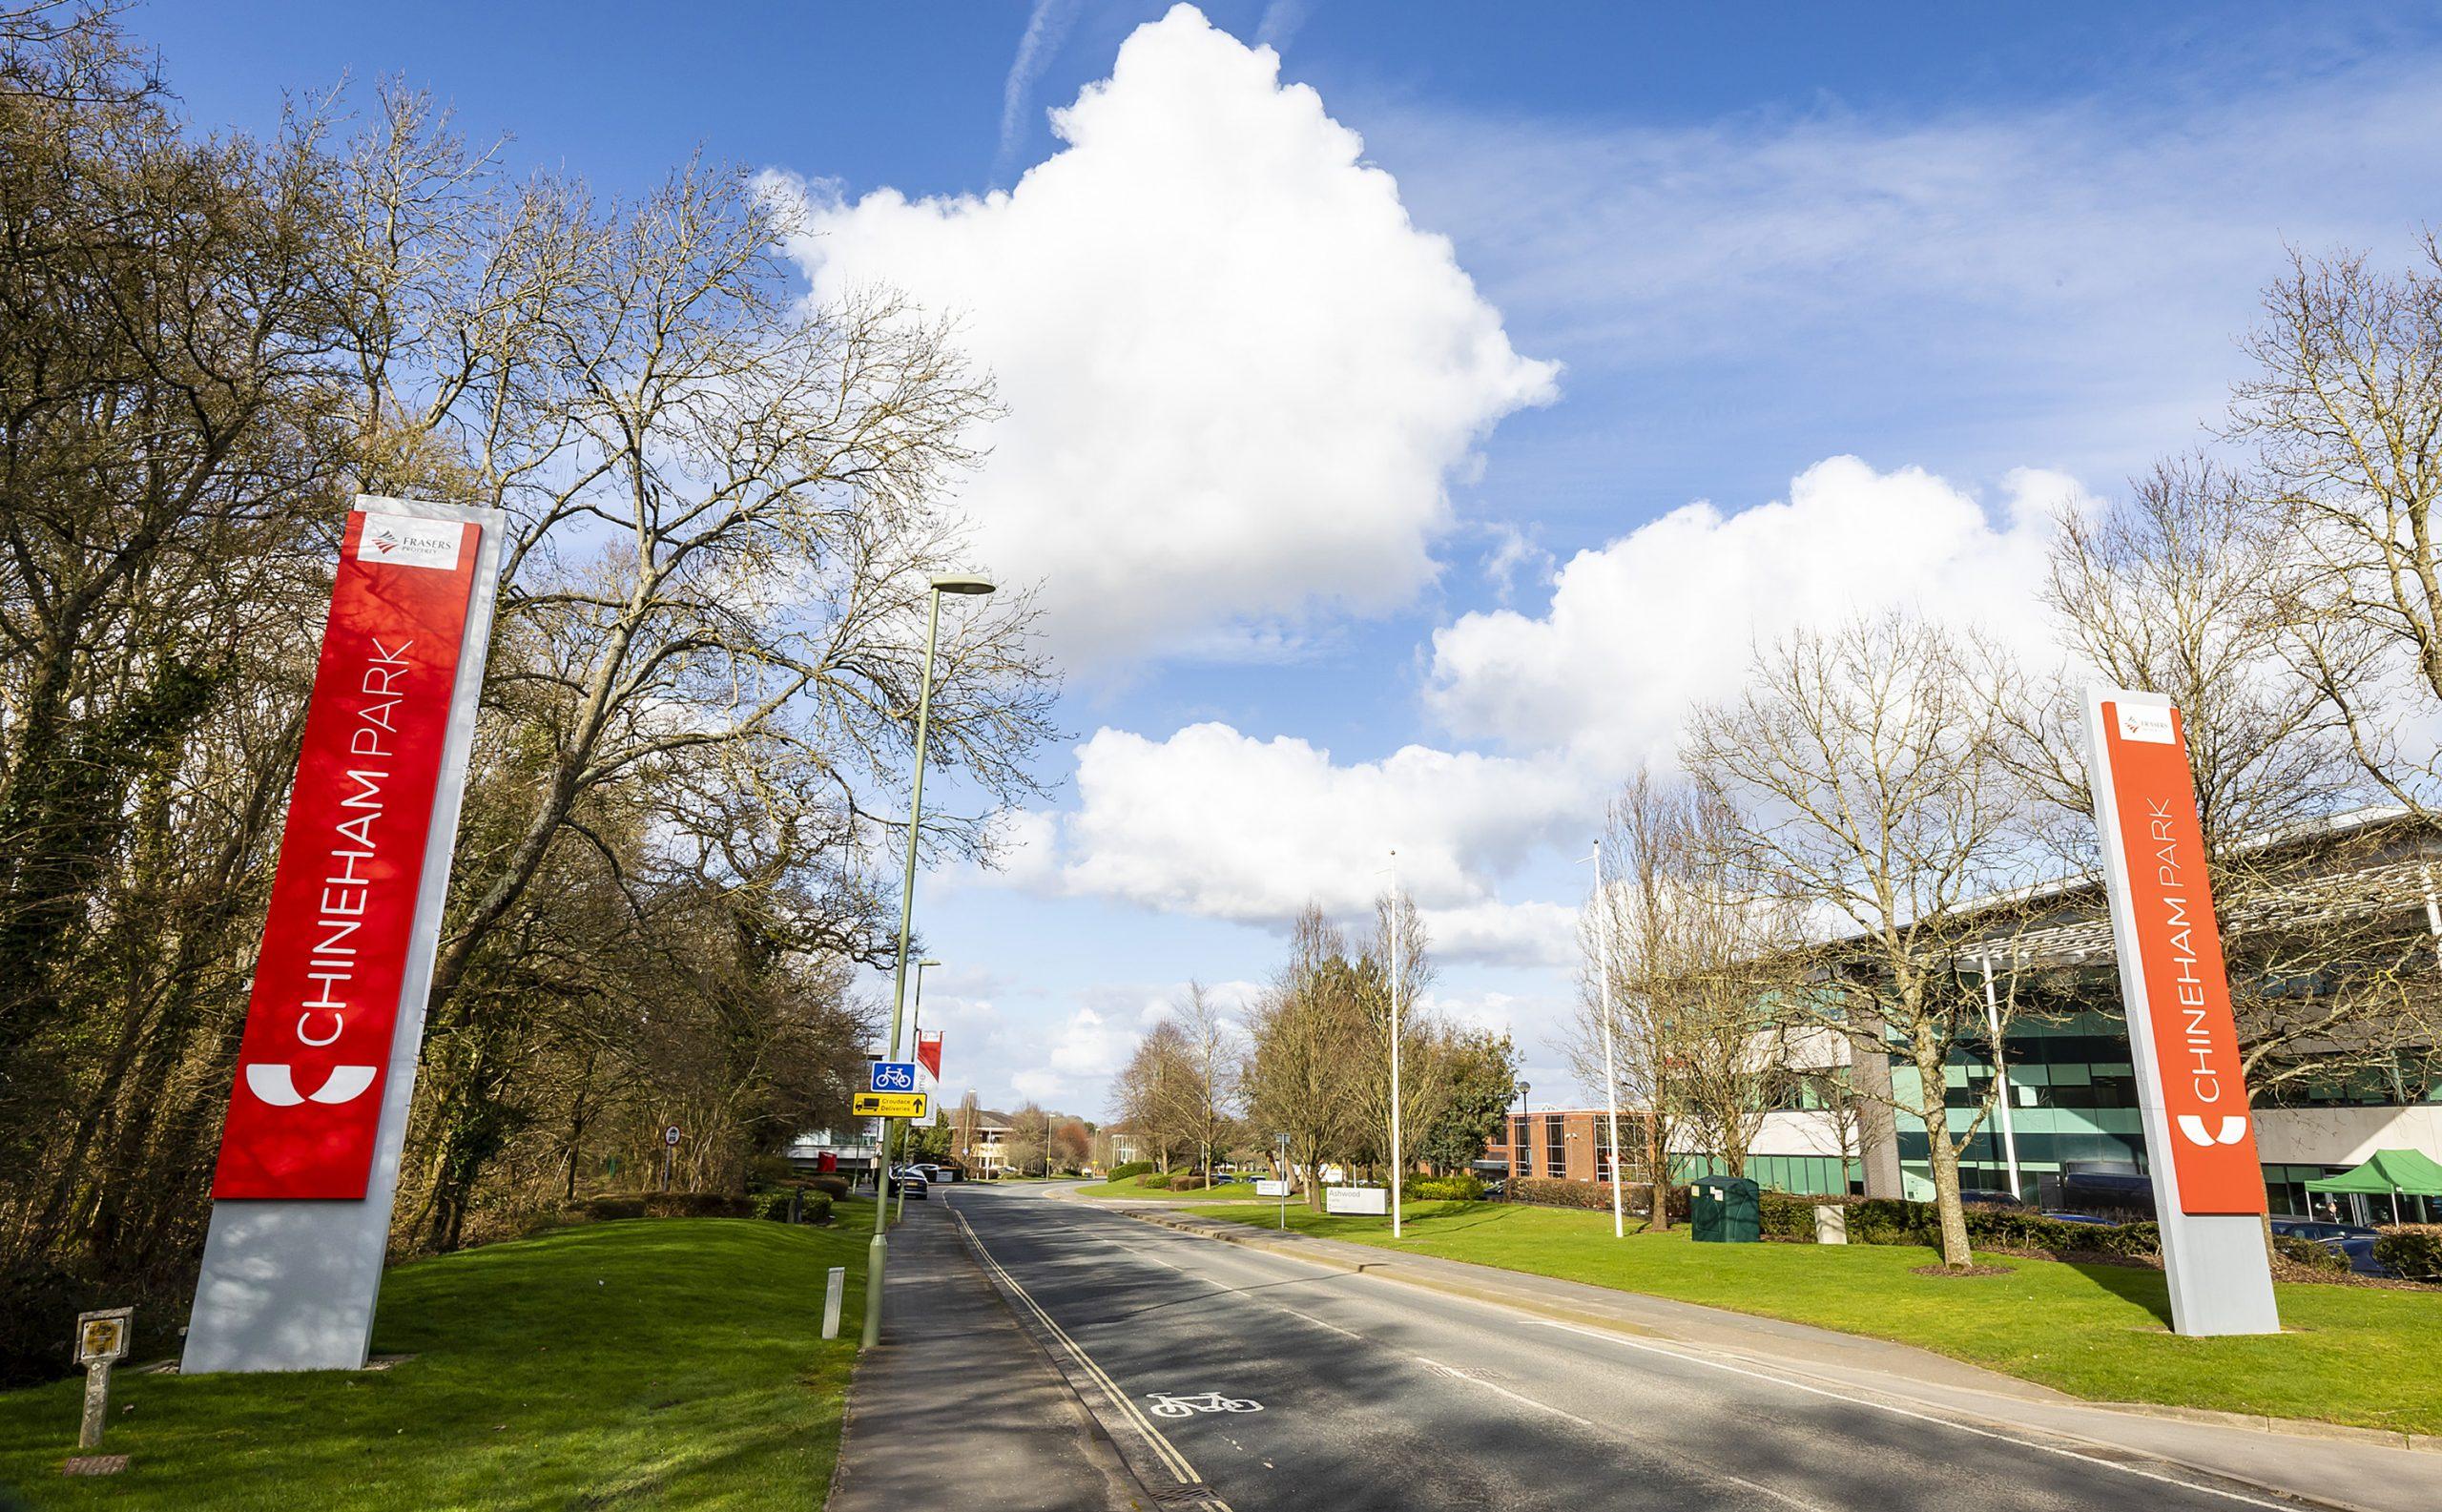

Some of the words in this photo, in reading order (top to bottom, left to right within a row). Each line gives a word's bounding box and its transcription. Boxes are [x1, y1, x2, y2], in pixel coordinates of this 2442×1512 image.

[402, 546, 437, 555] PROPERTY
[403, 537, 452, 550] FRASERS
[297, 769, 389, 1047] CHINEHAM
[349, 636, 415, 757] PARK
[2146, 797, 2185, 888] PARK
[2163, 897, 2222, 1104] CHINEHAM
[1329, 1190, 1360, 1198] Ashwood
